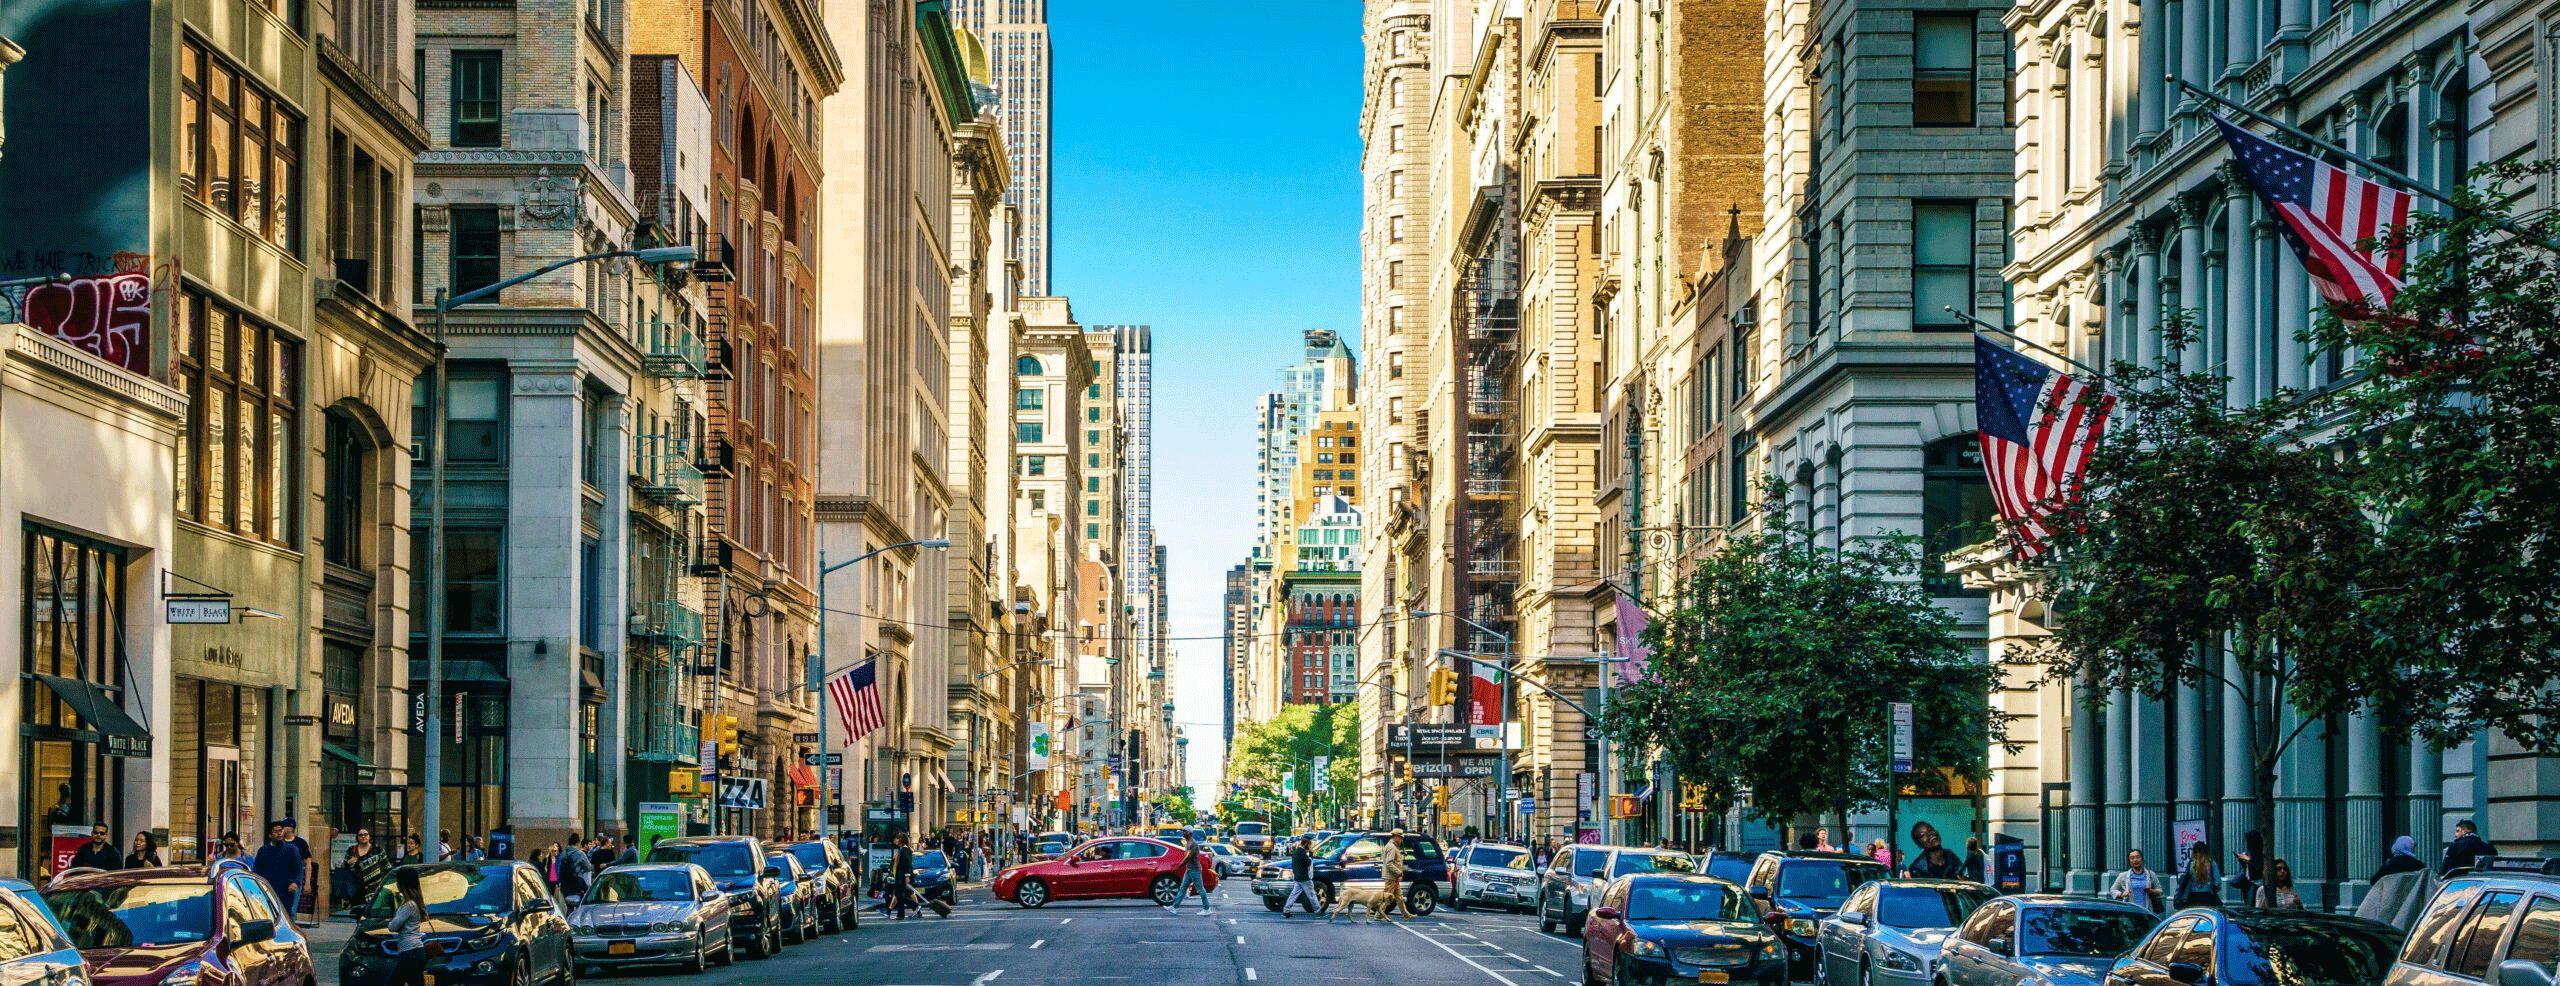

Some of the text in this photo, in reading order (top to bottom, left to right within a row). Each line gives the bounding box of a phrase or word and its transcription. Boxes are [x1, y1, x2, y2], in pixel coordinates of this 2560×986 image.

[2, 249, 26, 272] WE
[33, 250, 66, 272] HATE
[170, 607, 228, 615] WHITE BLACK
[332, 702, 355, 726] AVEDA
[416, 692, 425, 733] AVEDA
[109, 735, 148, 751] WHITE BLACK
[1459, 758, 1475, 766] WE
[1464, 767, 1493, 775] OPEN
[498, 842, 507, 855] P
[2007, 855, 2017, 868] P
